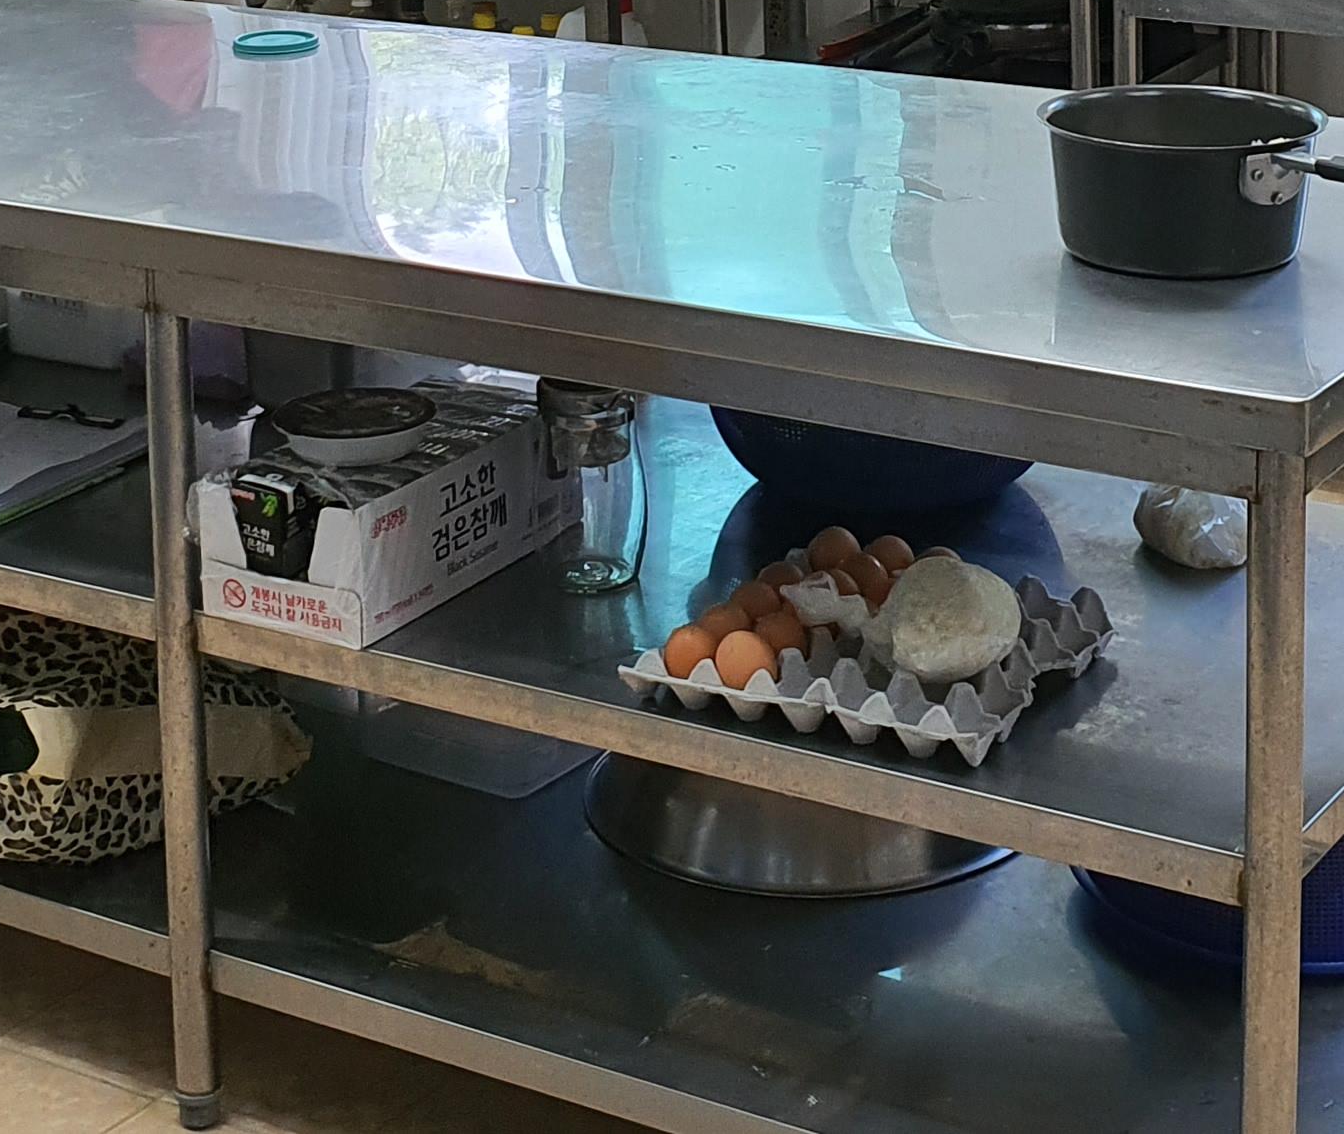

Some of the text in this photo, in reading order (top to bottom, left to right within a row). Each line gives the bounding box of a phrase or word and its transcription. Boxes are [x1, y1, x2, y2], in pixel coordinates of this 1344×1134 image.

[440, 460, 496, 517] 고소한
[242, 523, 271, 542] 고소한
[432, 492, 508, 562] 검은참깨
[251, 586, 327, 614] 개봉시 날카로운
[251, 600, 282, 619] 도구나
[300, 611, 342, 632] 사용금지
